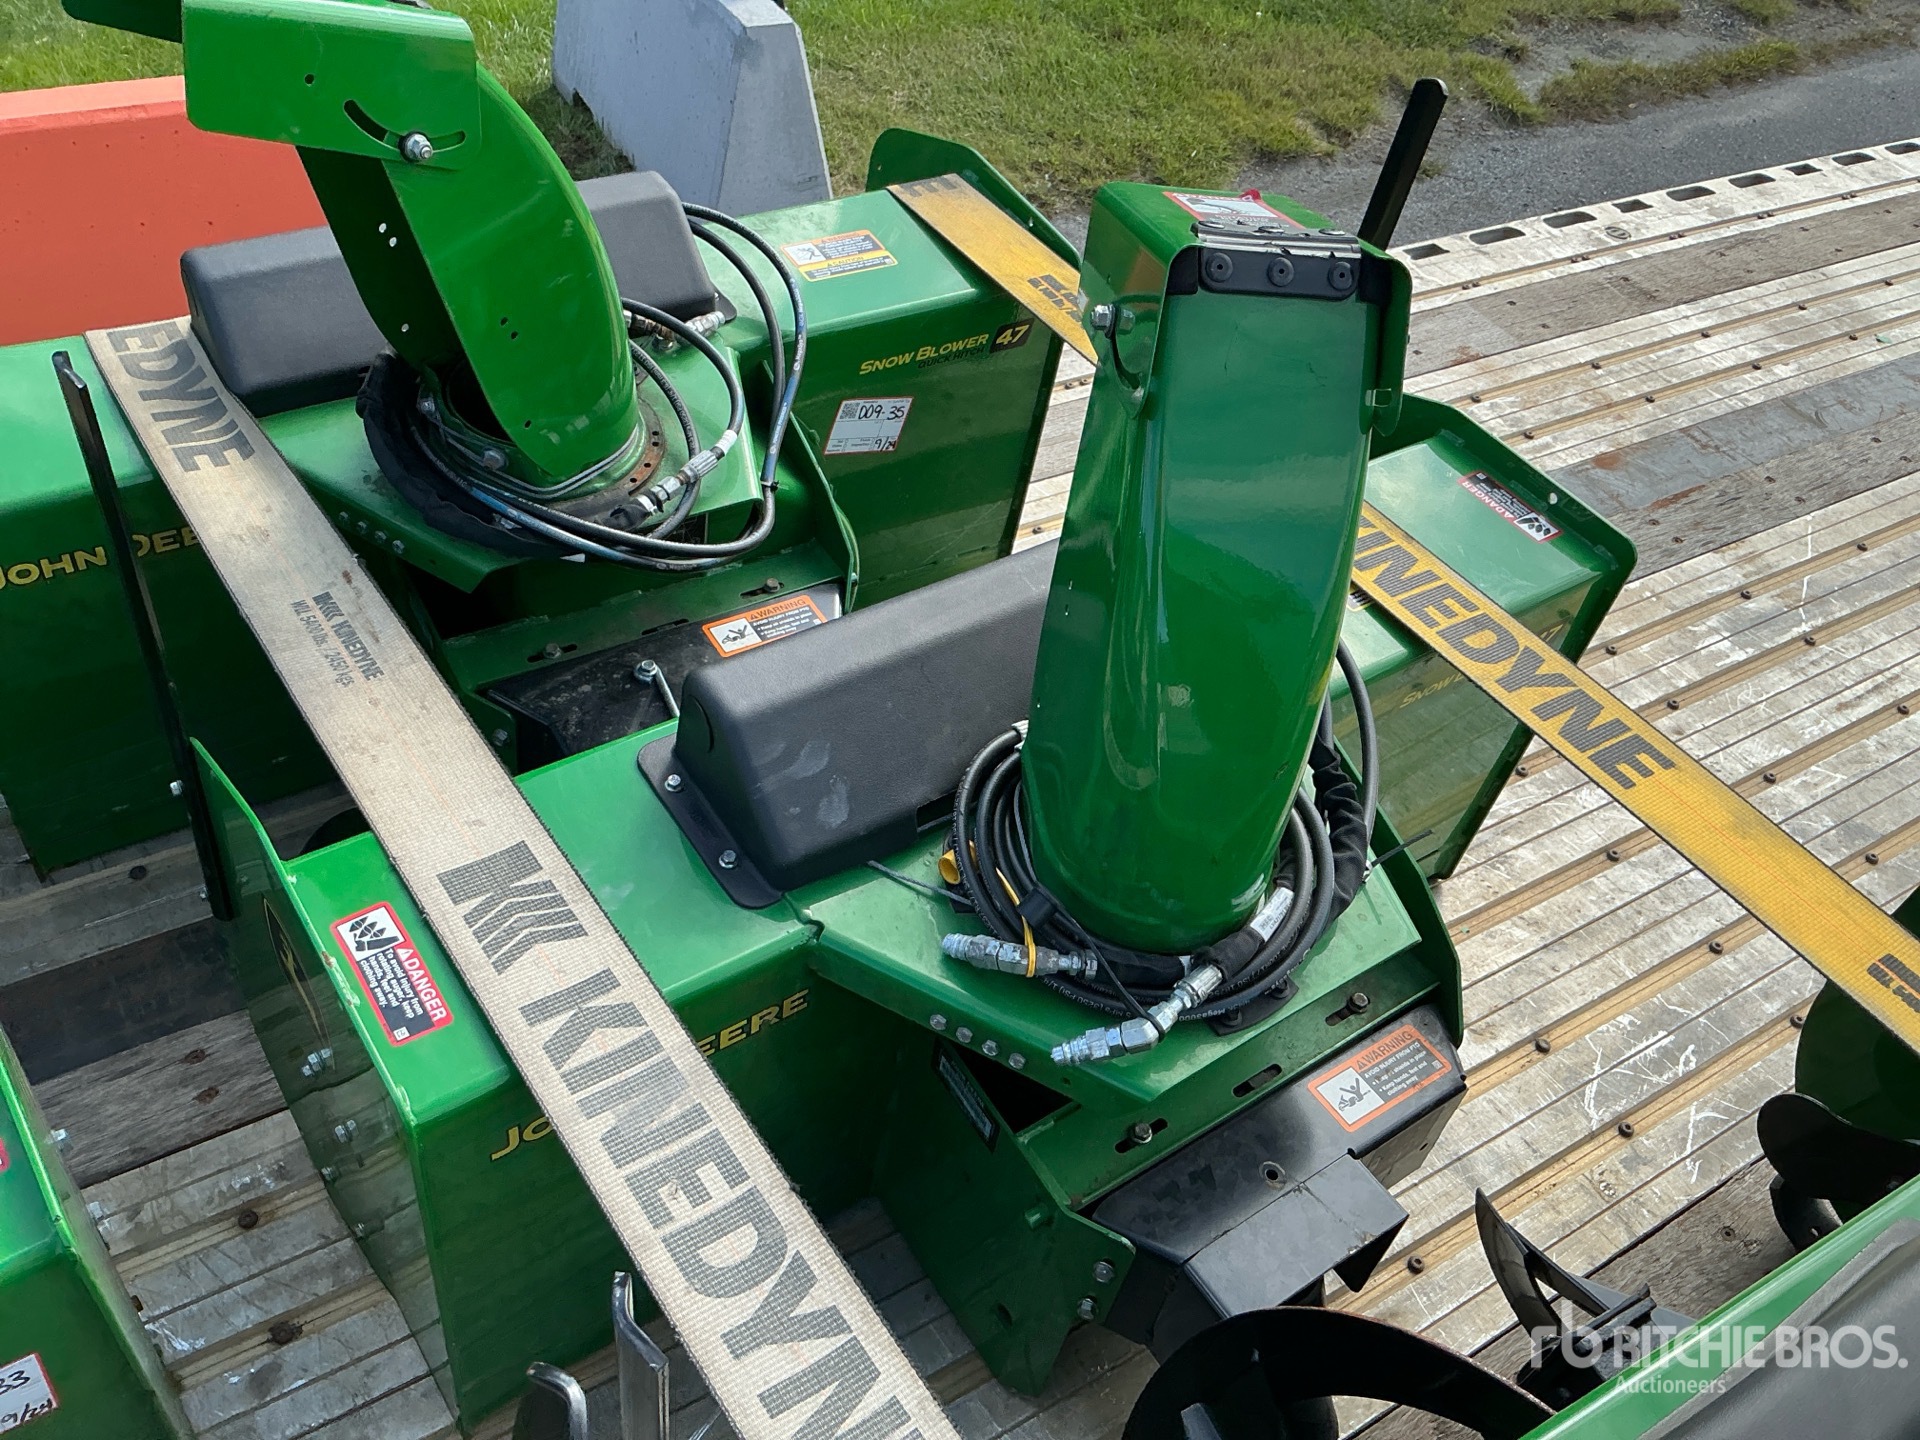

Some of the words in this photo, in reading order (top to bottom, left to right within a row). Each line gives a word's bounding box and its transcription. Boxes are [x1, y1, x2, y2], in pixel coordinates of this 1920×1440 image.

[859, 351, 915, 375] SNOW
[915, 333, 989, 361] BLOWER
[995, 324, 1030, 346] 47
[917, 354, 951, 369] QUICK
[952, 346, 985, 361] HITCH
[1460, 480, 1506, 513] DANGER
[756, 598, 806, 618] WARNING
[329, 619, 385, 682] KINEDYNE
[385, 948, 395, 958] To
[367, 955, 385, 979] hands,
[380, 978, 392, 992] feet
[386, 992, 399, 1007] and
[389, 958, 405, 977] avoid
[357, 959, 379, 988] clothing
[372, 987, 388, 1008] away.
[374, 952, 395, 979] rotating
[400, 1000, 416, 1019] keep
[398, 977, 416, 998] injury
[402, 957, 449, 1021] DANGER
[409, 997, 425, 1015] from
[1361, 1030, 1414, 1065] WARNING
[1363, 1066, 1380, 1078] AVOID
[1417, 1060, 1427, 1068] and
